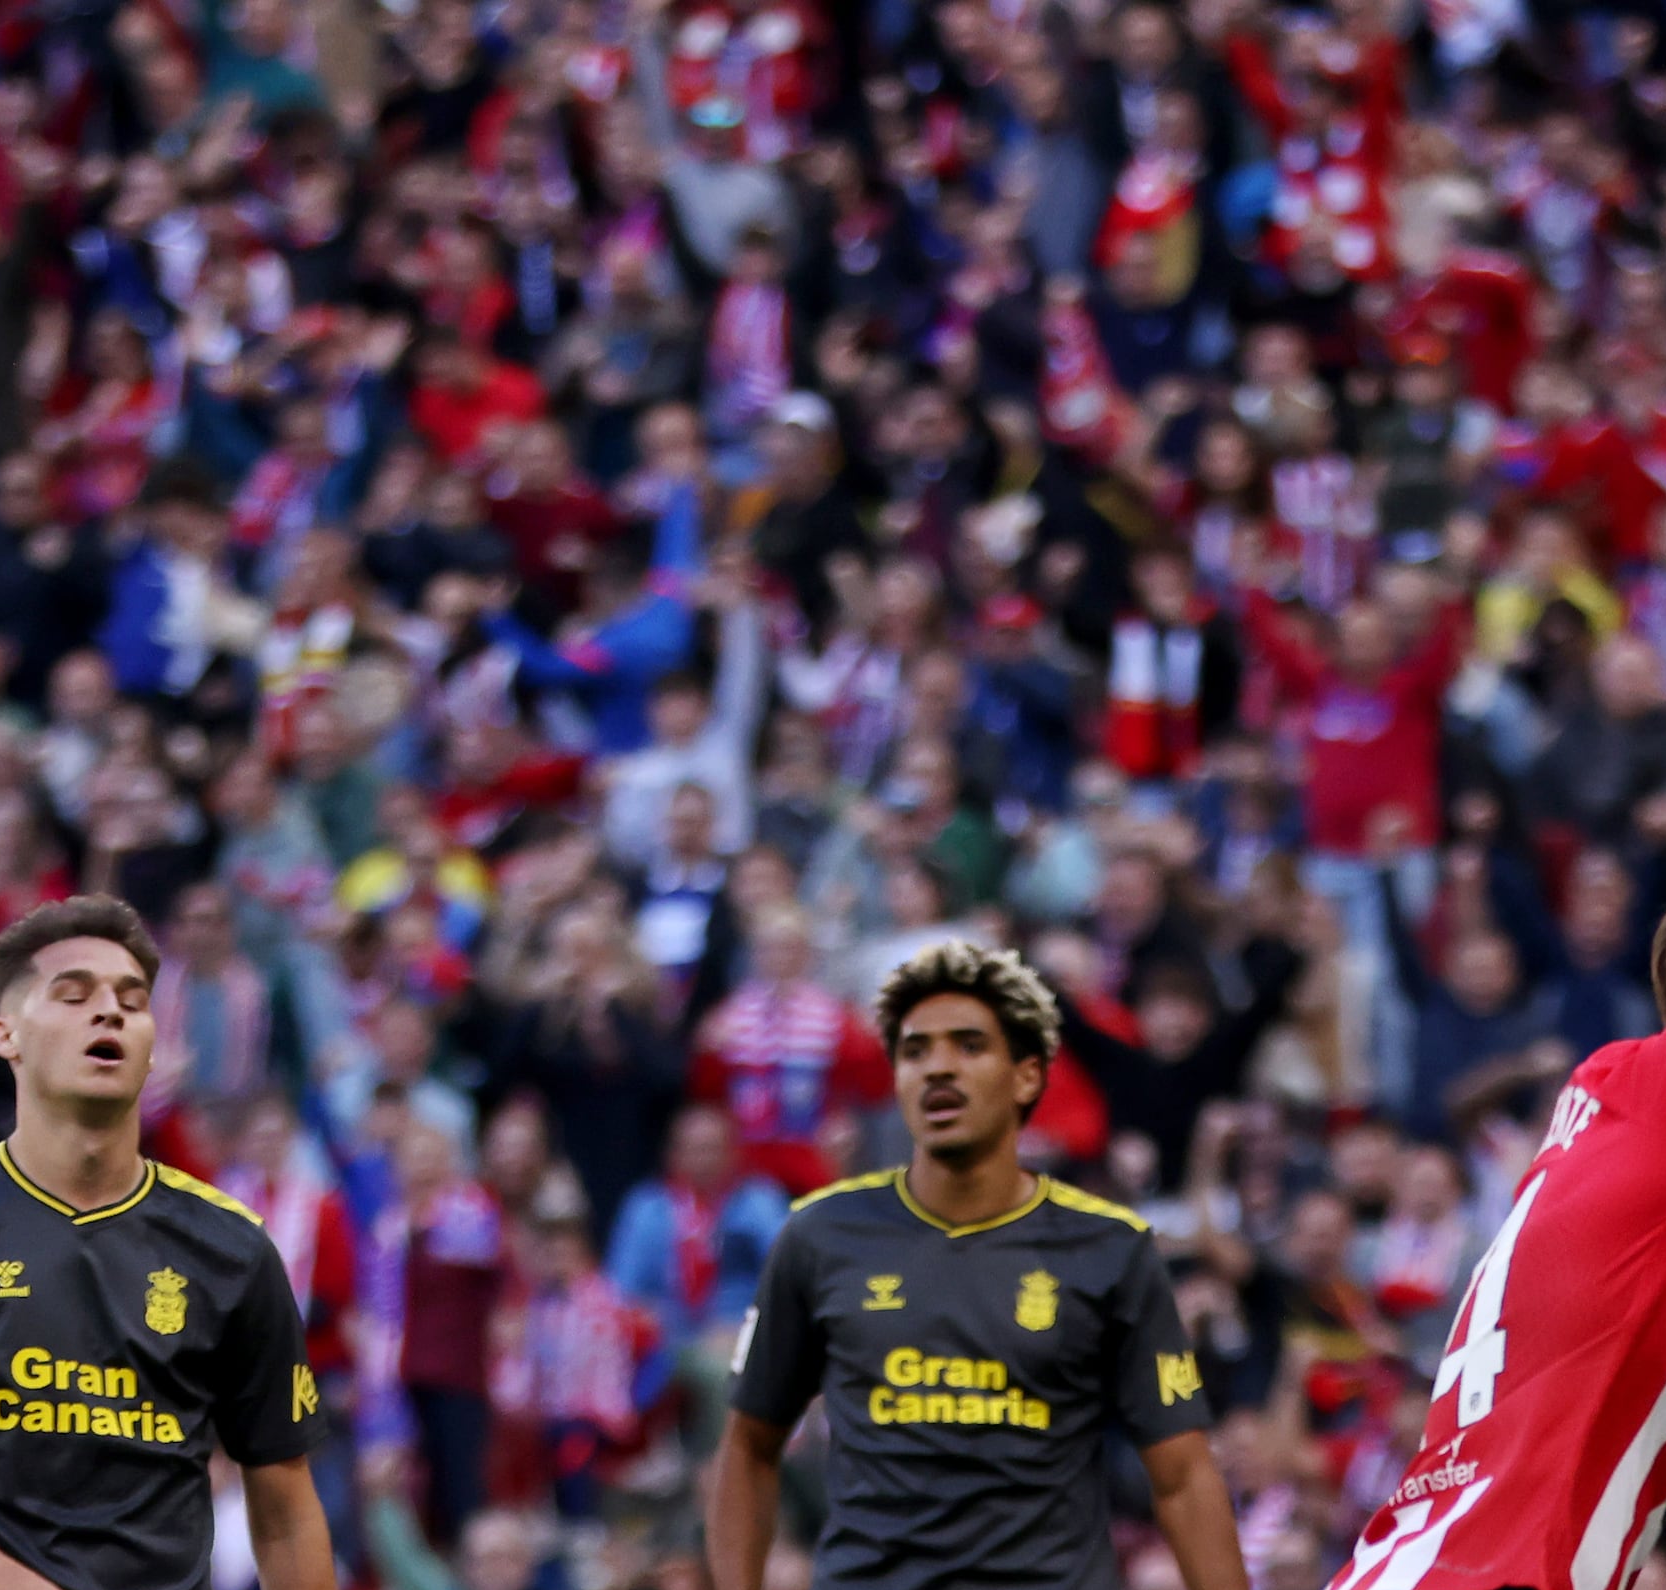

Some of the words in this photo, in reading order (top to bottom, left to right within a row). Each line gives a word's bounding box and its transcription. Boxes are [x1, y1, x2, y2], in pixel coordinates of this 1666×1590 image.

[11, 1347, 137, 1399] Gran
[884, 1347, 1007, 1390] Gran
[869, 1384, 1050, 1430] Canaria
